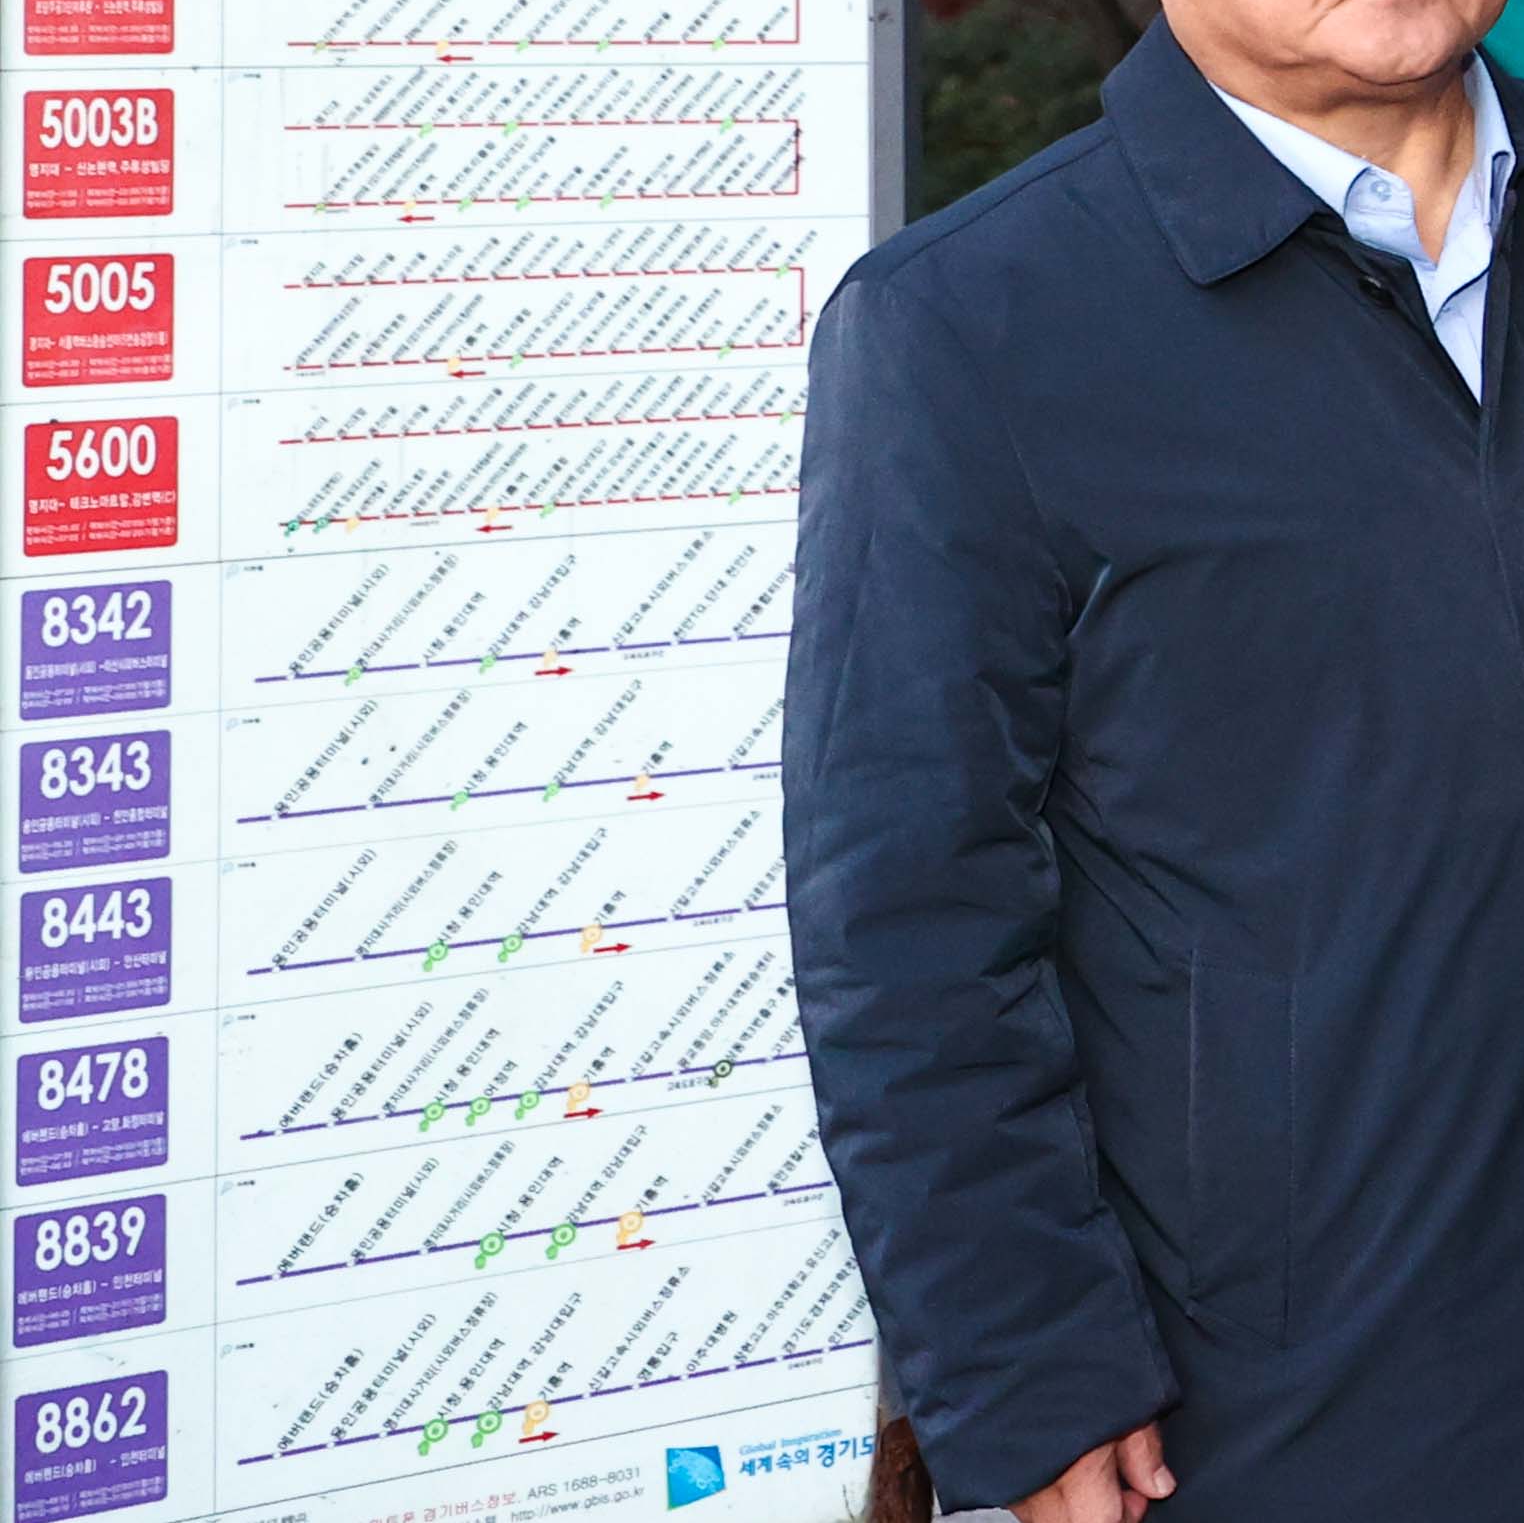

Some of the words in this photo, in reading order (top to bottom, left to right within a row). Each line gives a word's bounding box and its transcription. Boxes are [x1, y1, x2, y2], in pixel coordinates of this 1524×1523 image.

[40, 97, 158, 148] 5003B
[44, 262, 155, 314] 5005
[46, 424, 156, 480] 5600
[42, 590, 152, 647] 8342
[41, 740, 151, 799] 8343
[41, 888, 152, 948] 8443
[38, 1048, 149, 1110] 8478
[35, 1206, 146, 1271] 8839
[35, 1386, 146, 1453] 8862
[527, 1483, 558, 1500] ARS
[564, 1467, 641, 1493] 1688-8031
